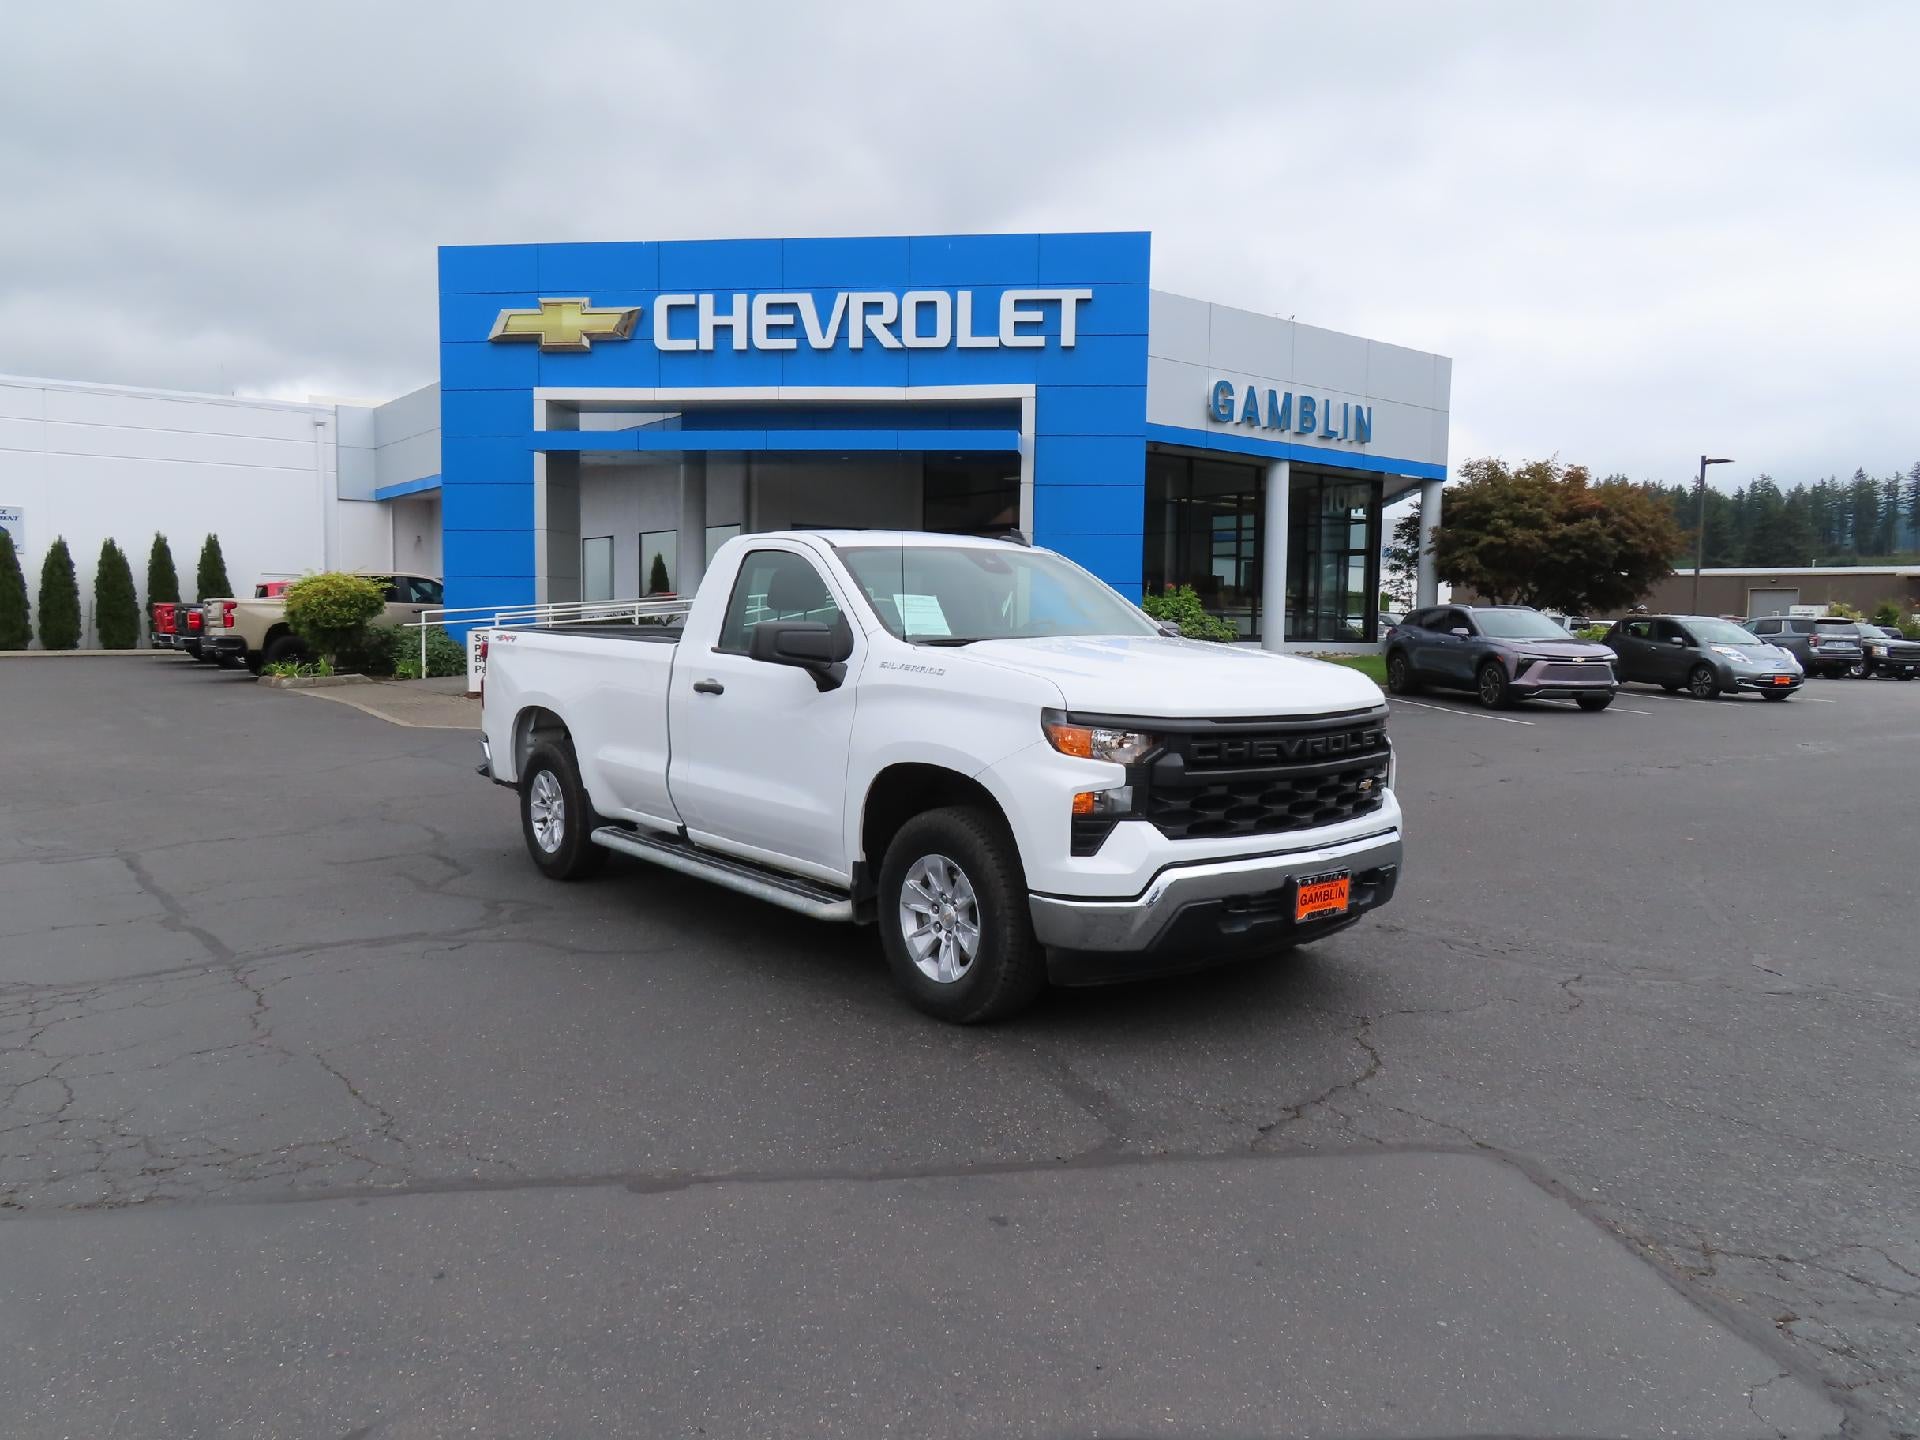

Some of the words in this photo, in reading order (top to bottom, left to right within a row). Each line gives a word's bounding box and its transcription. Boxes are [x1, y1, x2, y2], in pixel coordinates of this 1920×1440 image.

[653, 289, 1092, 350] CHEVROLET
[1208, 380, 1372, 444] GAMBLIN
[879, 661, 946, 676] SILVERADO
[1190, 727, 1387, 761] CHEVROLET
[1300, 886, 1345, 906] GAMBLIN
